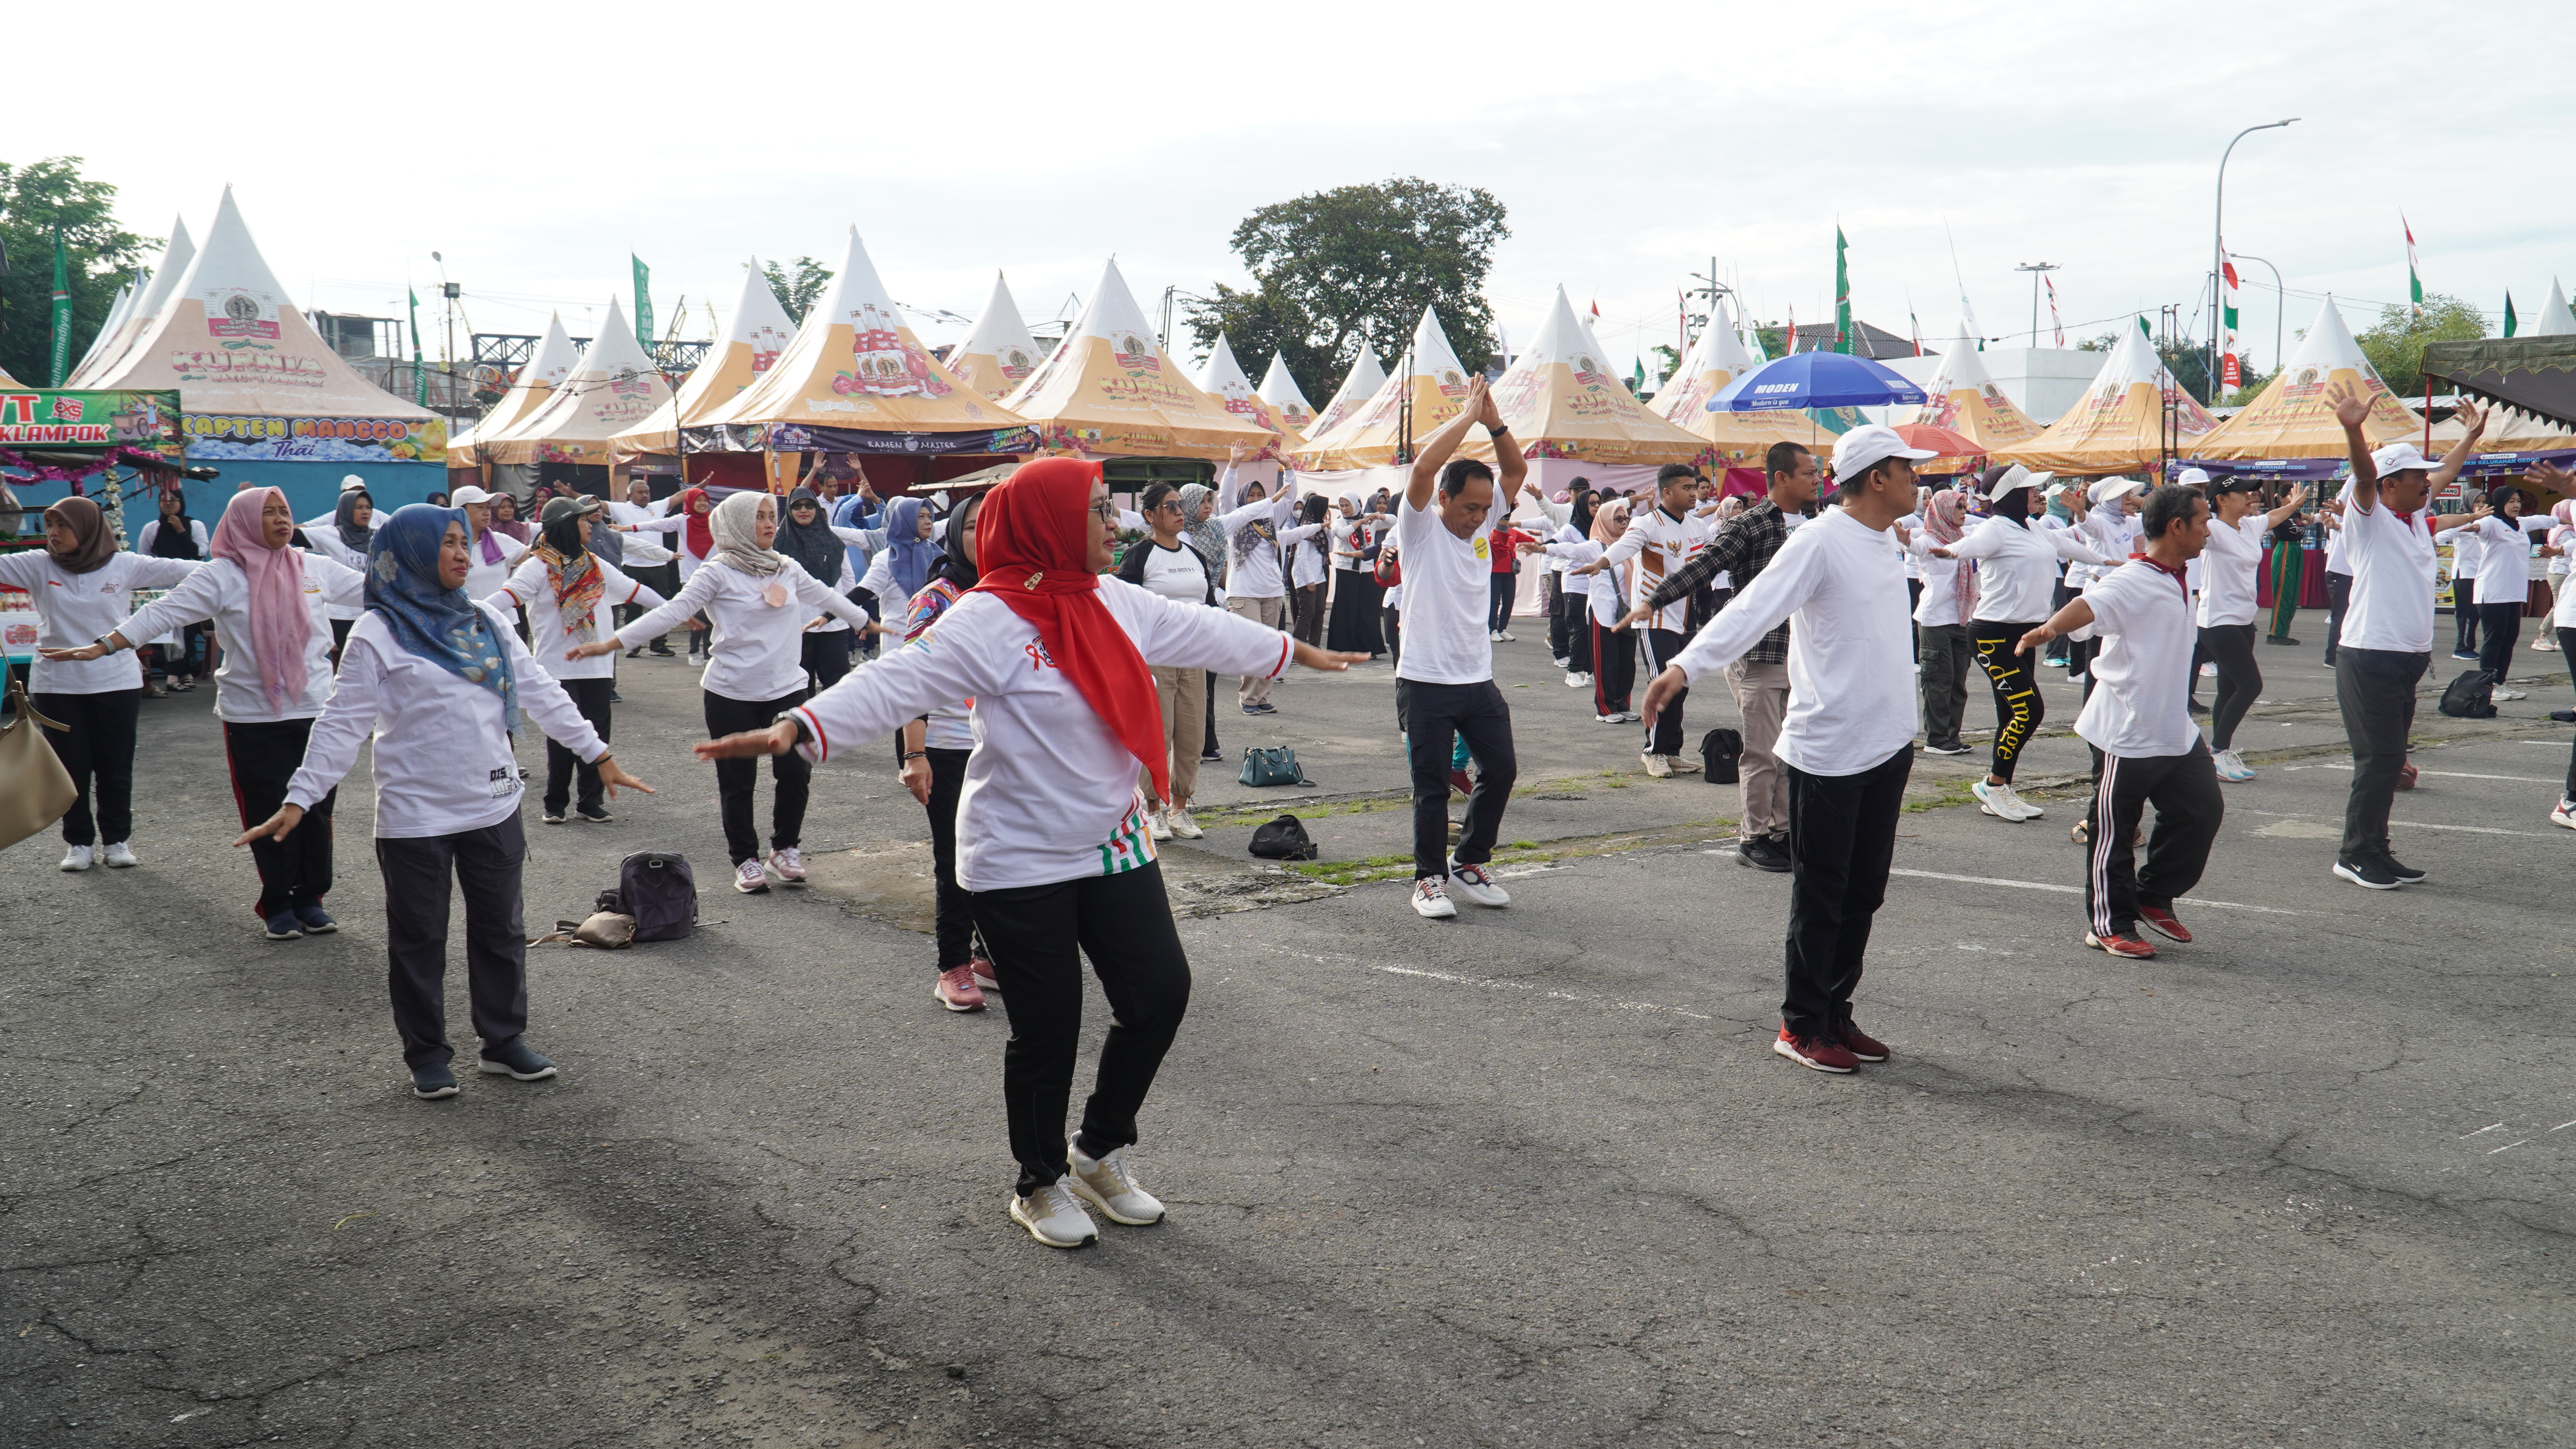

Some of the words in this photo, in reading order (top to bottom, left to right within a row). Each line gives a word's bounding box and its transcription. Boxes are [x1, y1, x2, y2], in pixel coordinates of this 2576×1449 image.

[173, 351, 326, 377] KURNIA
[1098, 377, 1195, 402] KURNIA
[1754, 383, 1799, 394] MODEN
[1884, 380, 1911, 388] MODEN
[806, 398, 857, 412] Superbrands
[180, 415, 287, 438] KAPTEN
[292, 418, 409, 440] MANGGO
[867, 440, 902, 449] RAMEN
[920, 440, 957, 449] MASTER
[1123, 431, 1170, 446] KURNIA
[272, 439, 318, 458] Thai
[1976, 637, 2020, 691] body
[1997, 687, 2035, 760] Image
